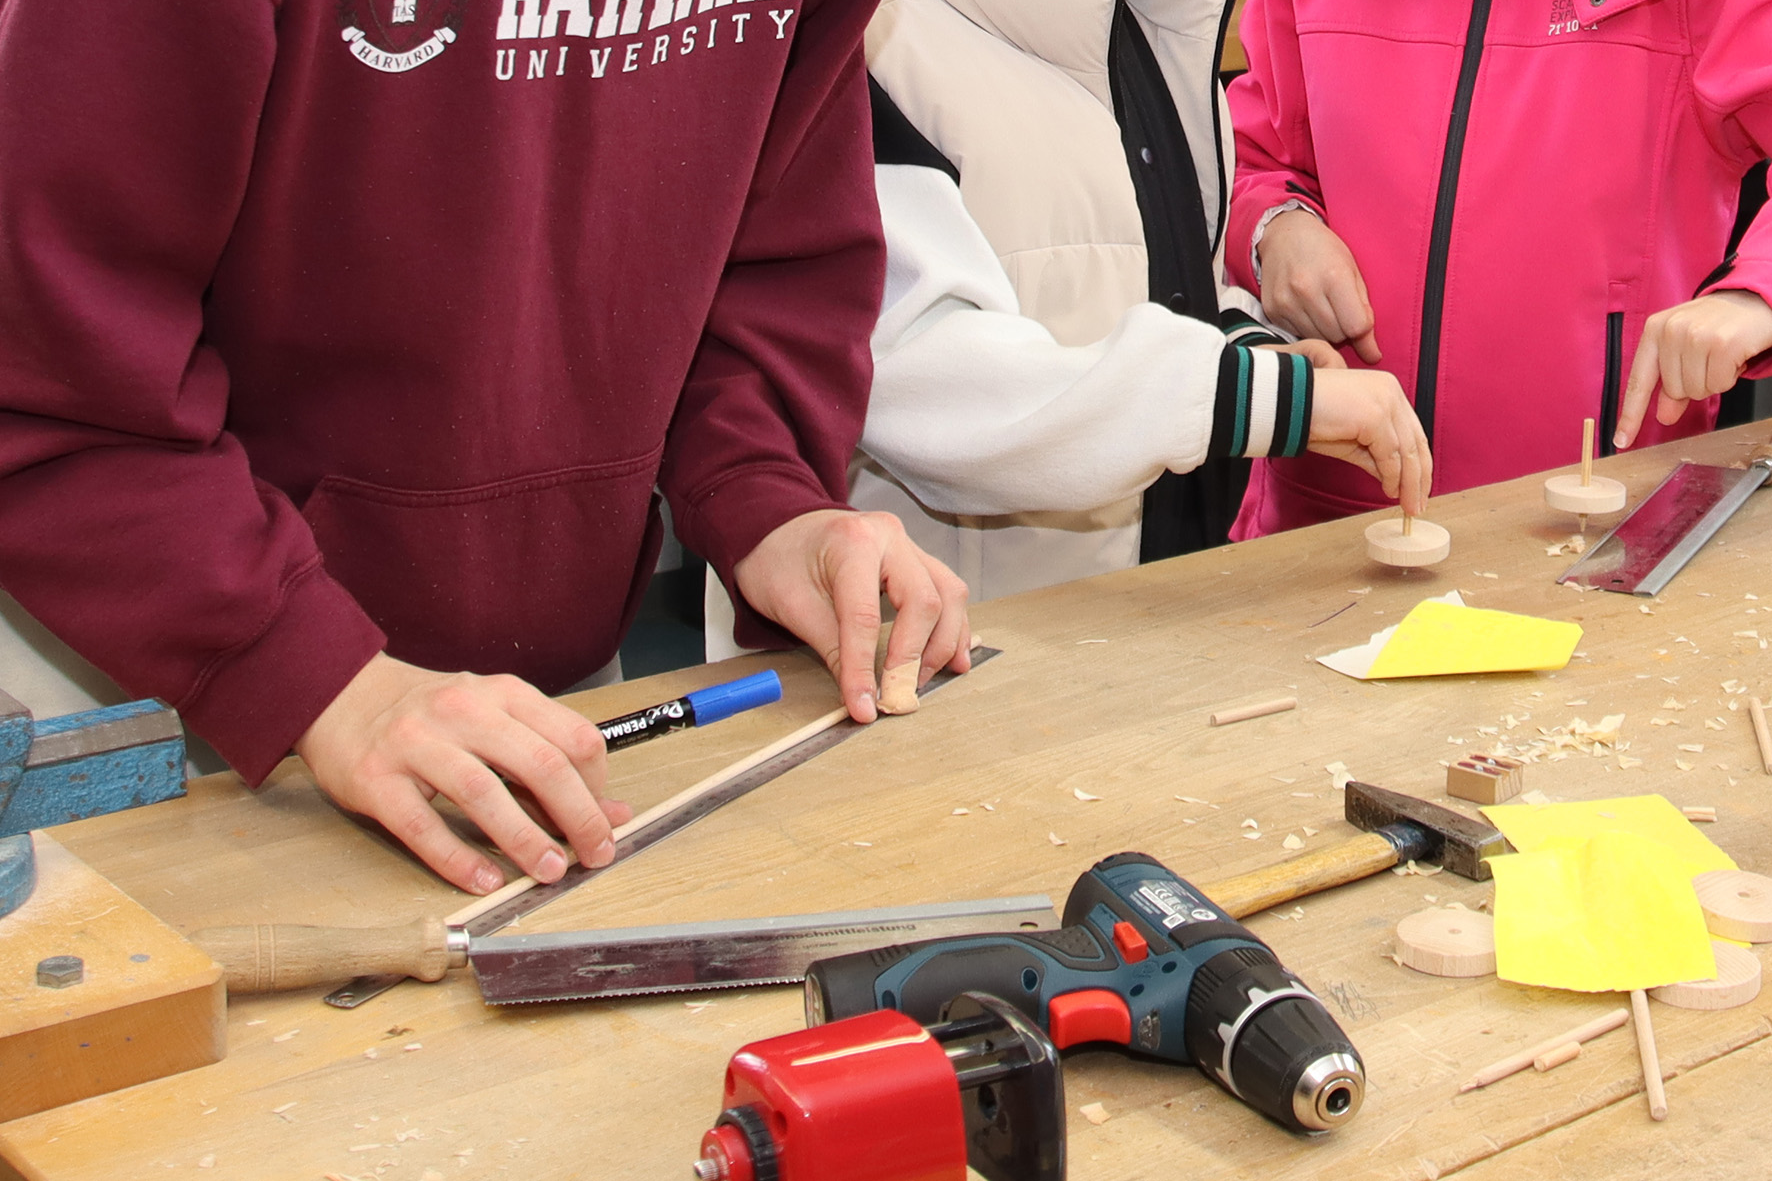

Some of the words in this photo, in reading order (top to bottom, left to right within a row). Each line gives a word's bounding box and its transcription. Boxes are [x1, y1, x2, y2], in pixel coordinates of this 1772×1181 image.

[357, 42, 435, 69] HARVARD
[496, 9, 795, 80] UNIVERSITY
[602, 717, 648, 740] PERMA
